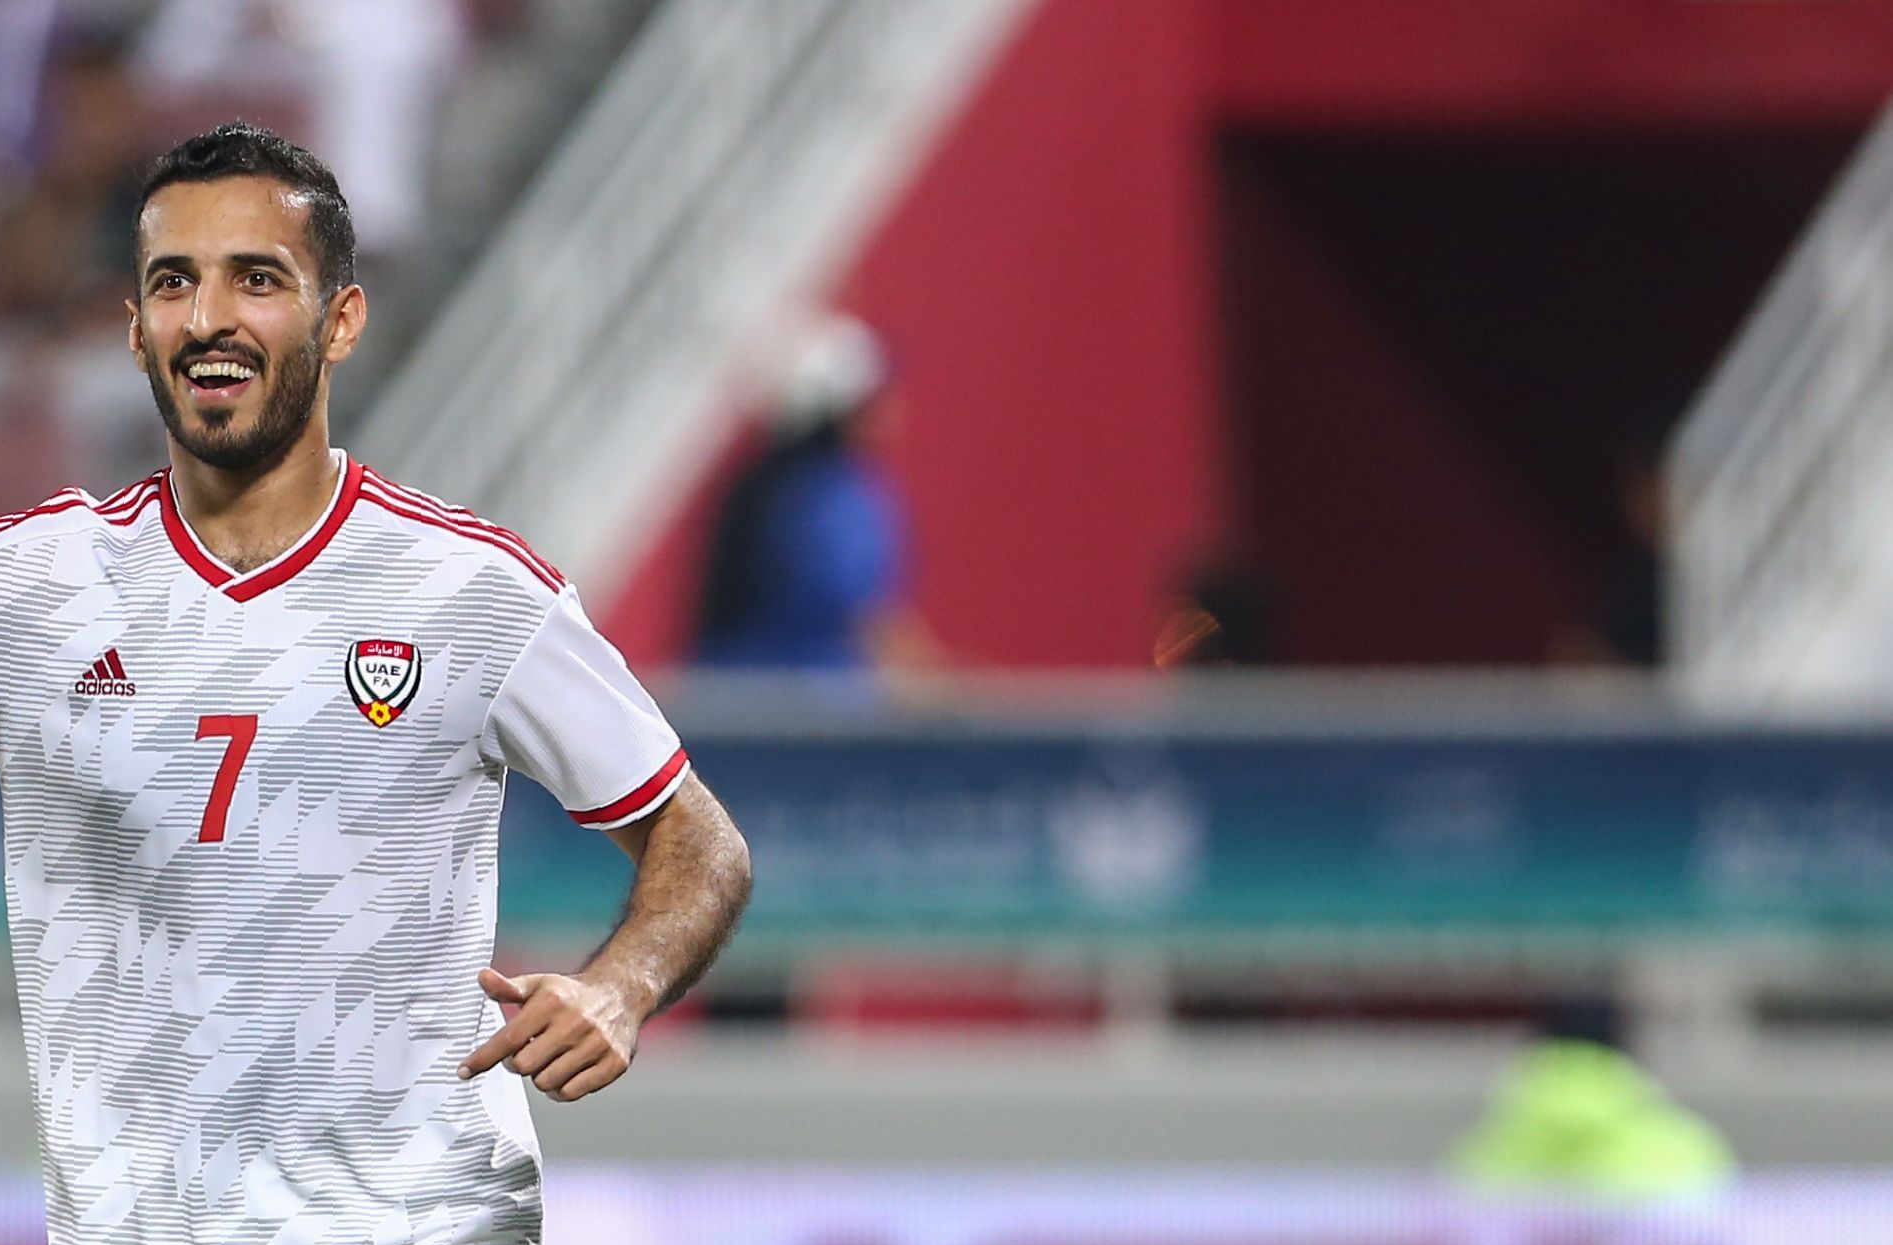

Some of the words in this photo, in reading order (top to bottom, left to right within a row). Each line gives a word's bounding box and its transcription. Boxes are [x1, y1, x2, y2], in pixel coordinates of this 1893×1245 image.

[366, 663, 401, 676] UAE
[75, 678, 136, 696] adidas
[373, 677, 391, 688] FA
[195, 714, 258, 843] 7
